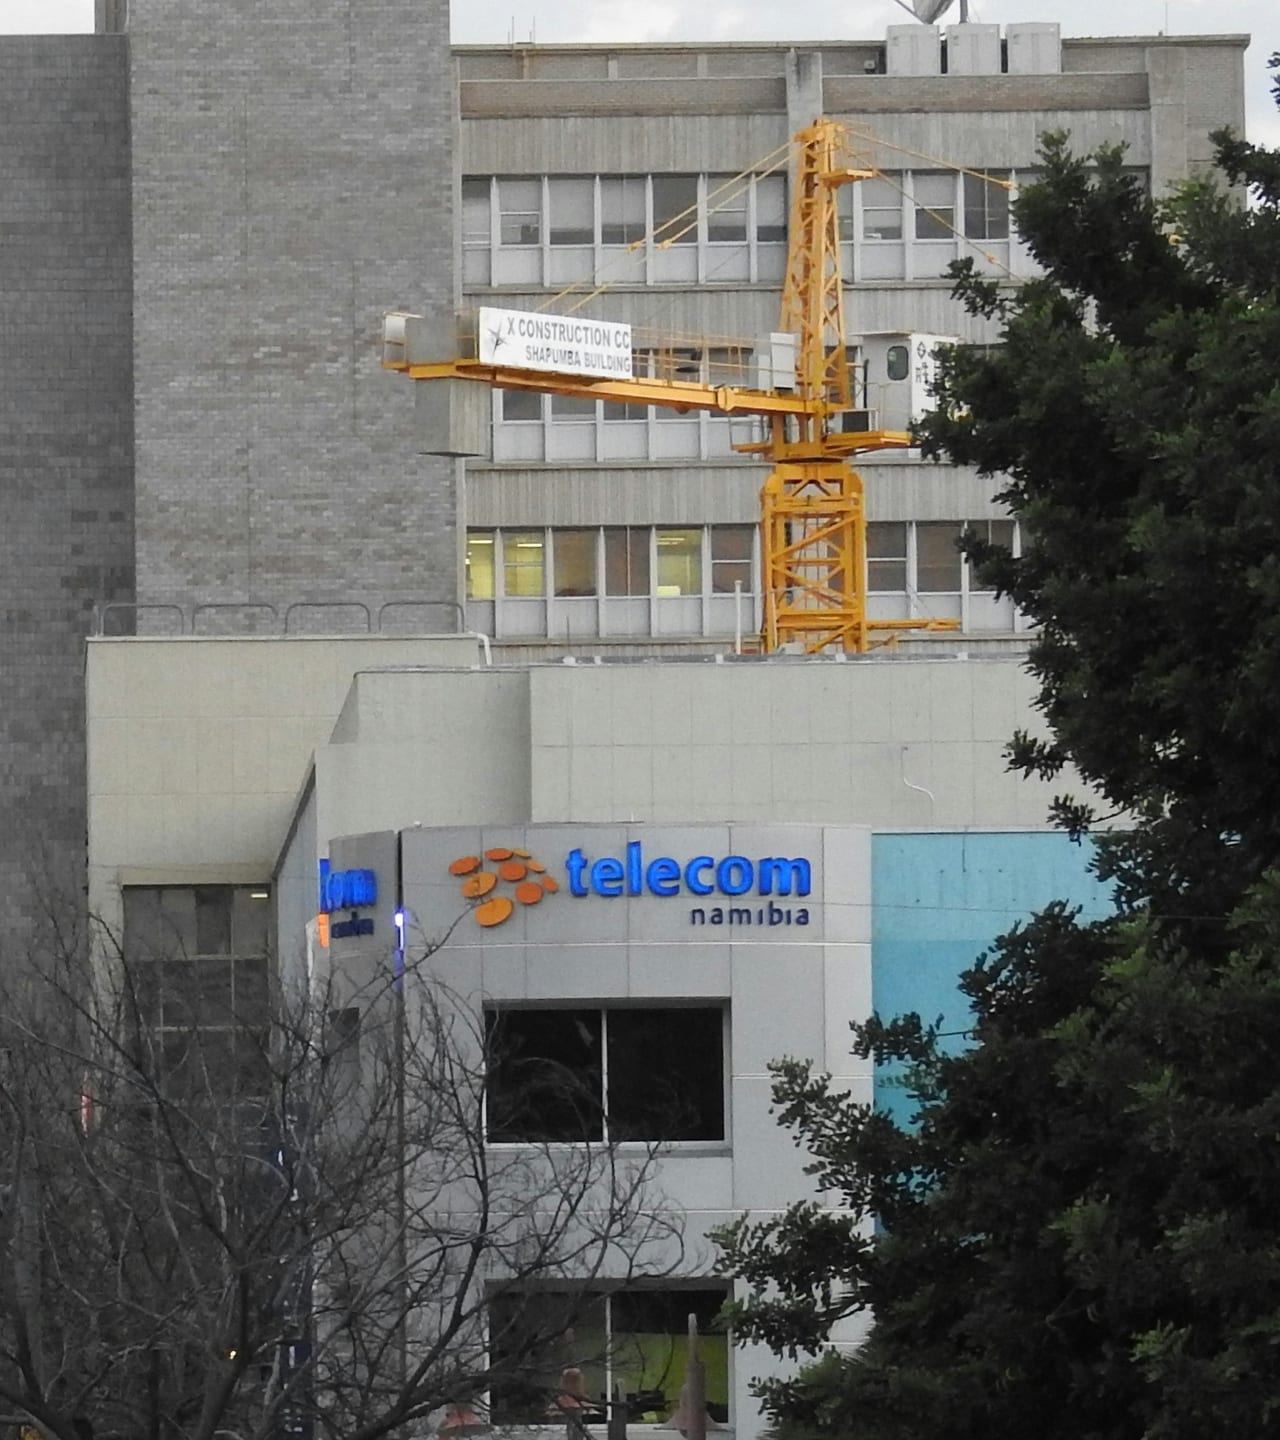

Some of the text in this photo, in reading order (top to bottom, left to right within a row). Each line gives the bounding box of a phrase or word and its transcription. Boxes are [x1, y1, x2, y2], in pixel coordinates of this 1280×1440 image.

[506, 316, 630, 350] X CONSTRUCTION CC
[525, 345, 631, 373] SHAPUMBA BUILDING
[565, 840, 812, 898] telecom
[690, 901, 810, 926] namibia
